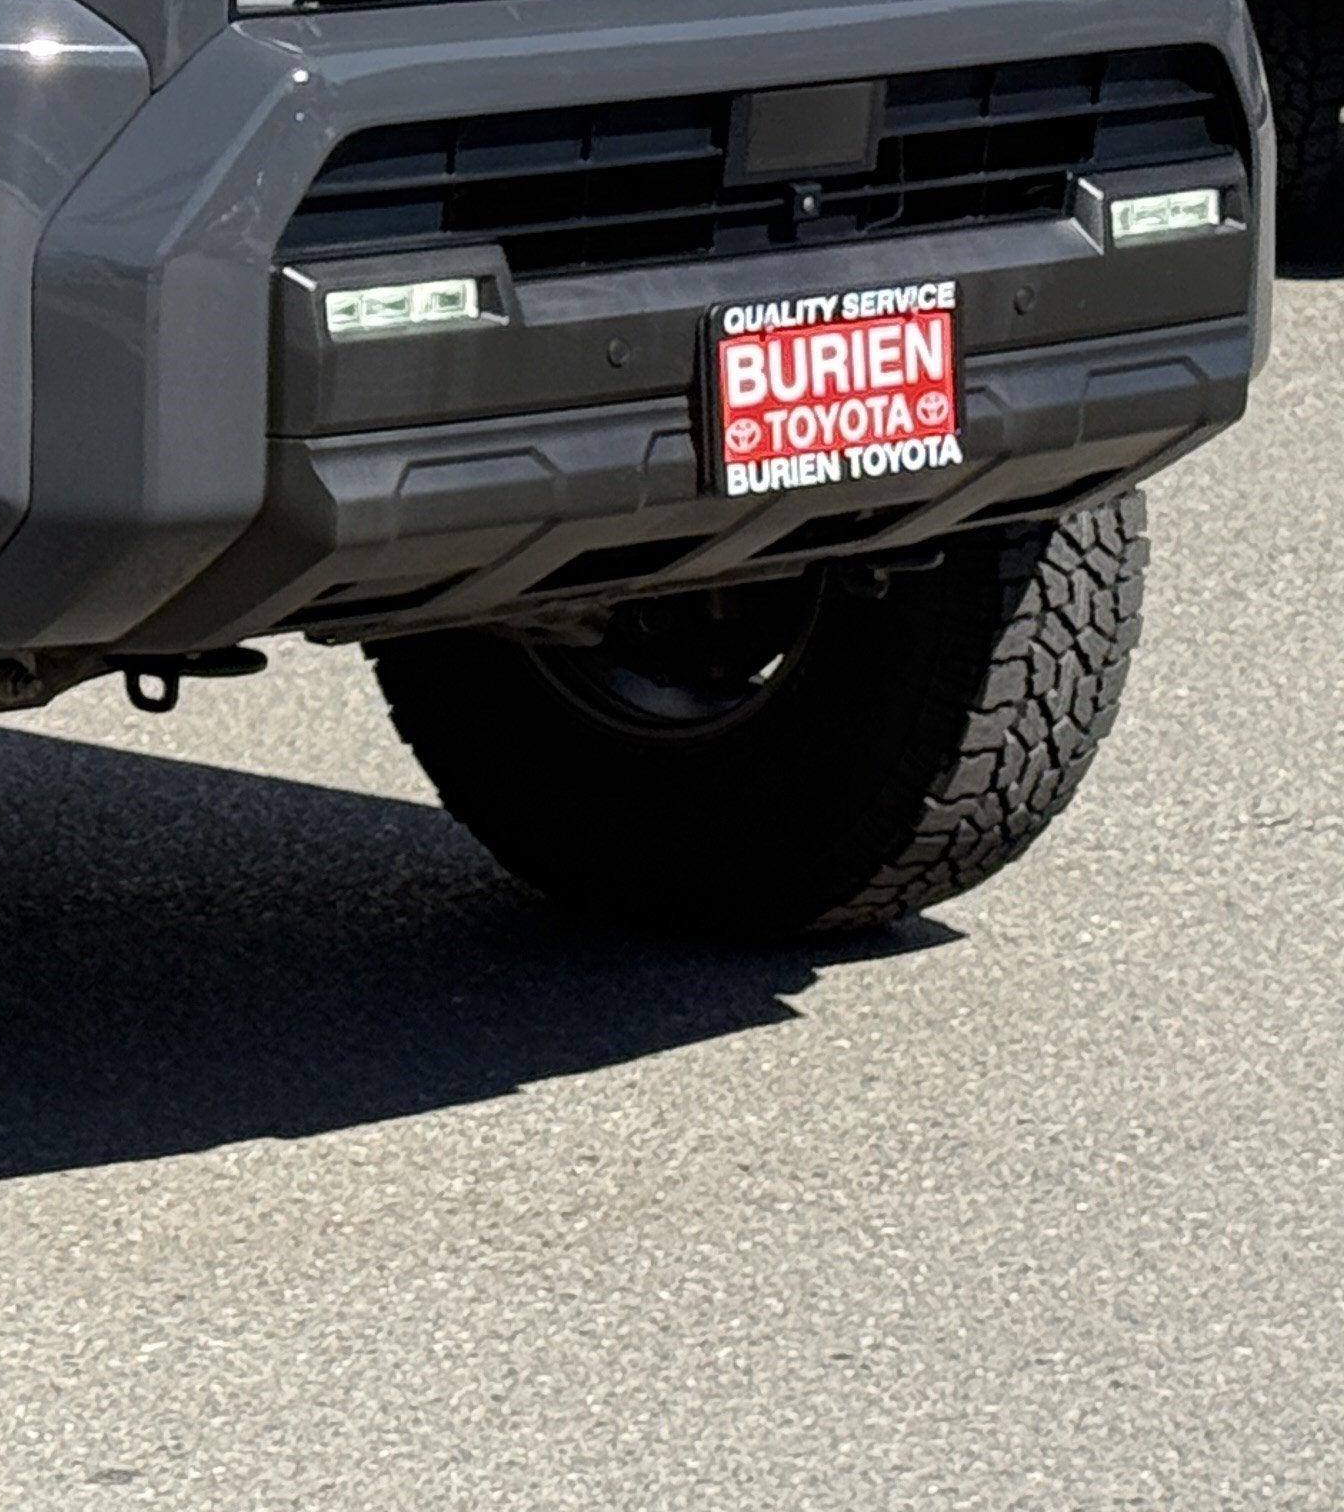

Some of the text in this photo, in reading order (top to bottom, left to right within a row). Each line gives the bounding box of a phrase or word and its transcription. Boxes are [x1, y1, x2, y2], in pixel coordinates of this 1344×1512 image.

[723, 281, 956, 335] QUALITY SERVICE
[726, 319, 943, 408] BURIEN
[763, 393, 914, 451] TOYOTA
[727, 434, 962, 496] BURIEN TOYOTA
